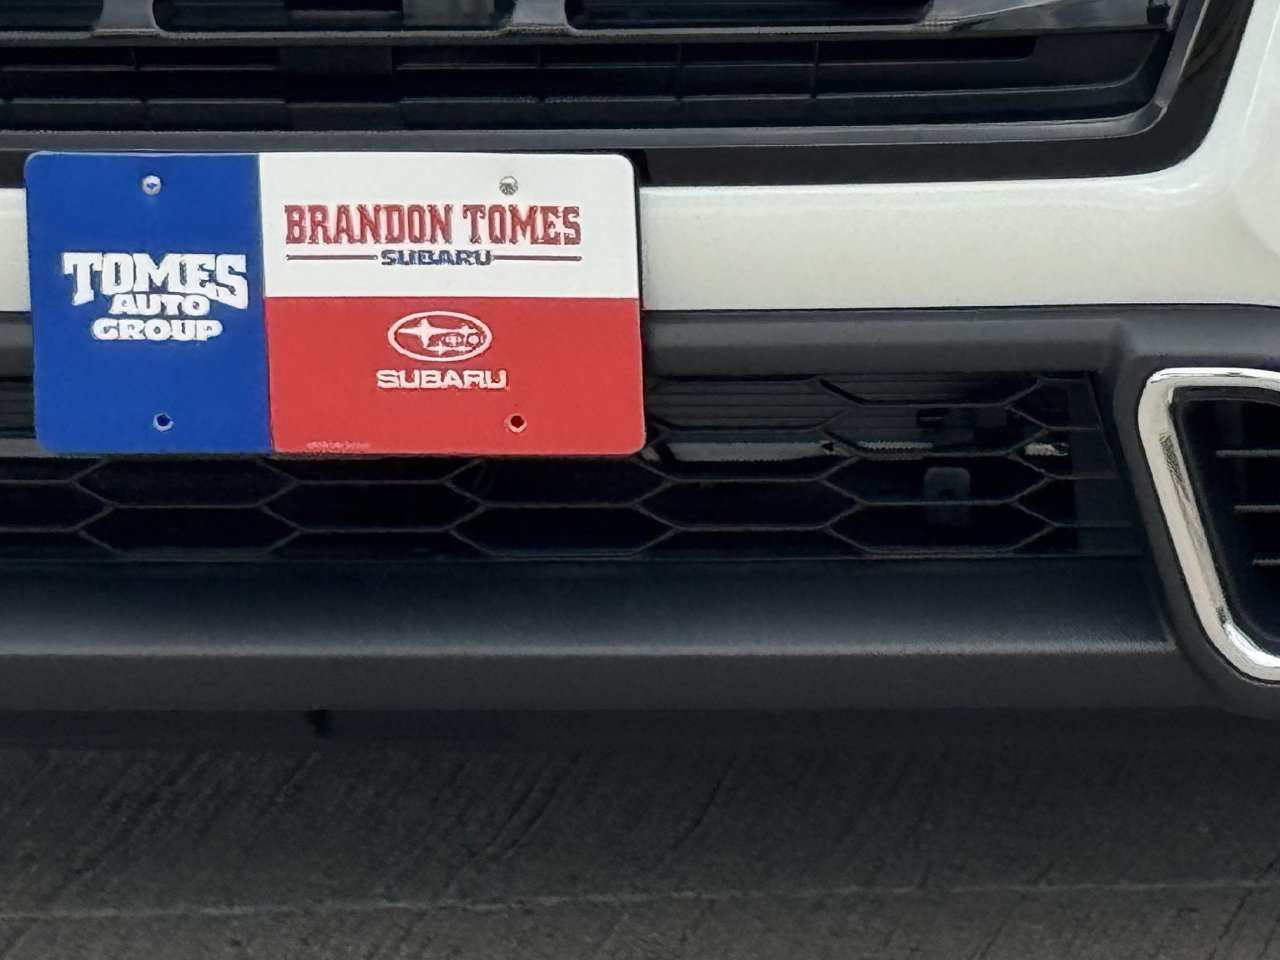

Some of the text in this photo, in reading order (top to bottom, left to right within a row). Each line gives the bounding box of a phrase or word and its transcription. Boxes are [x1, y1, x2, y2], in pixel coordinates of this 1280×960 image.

[284, 203, 582, 246] BRANDON TOMES
[380, 249, 493, 266] SUBARU
[63, 252, 249, 310] TOMES
[109, 294, 211, 316] AUTO
[91, 318, 223, 341] GROUP
[376, 369, 508, 390] SUBARU
